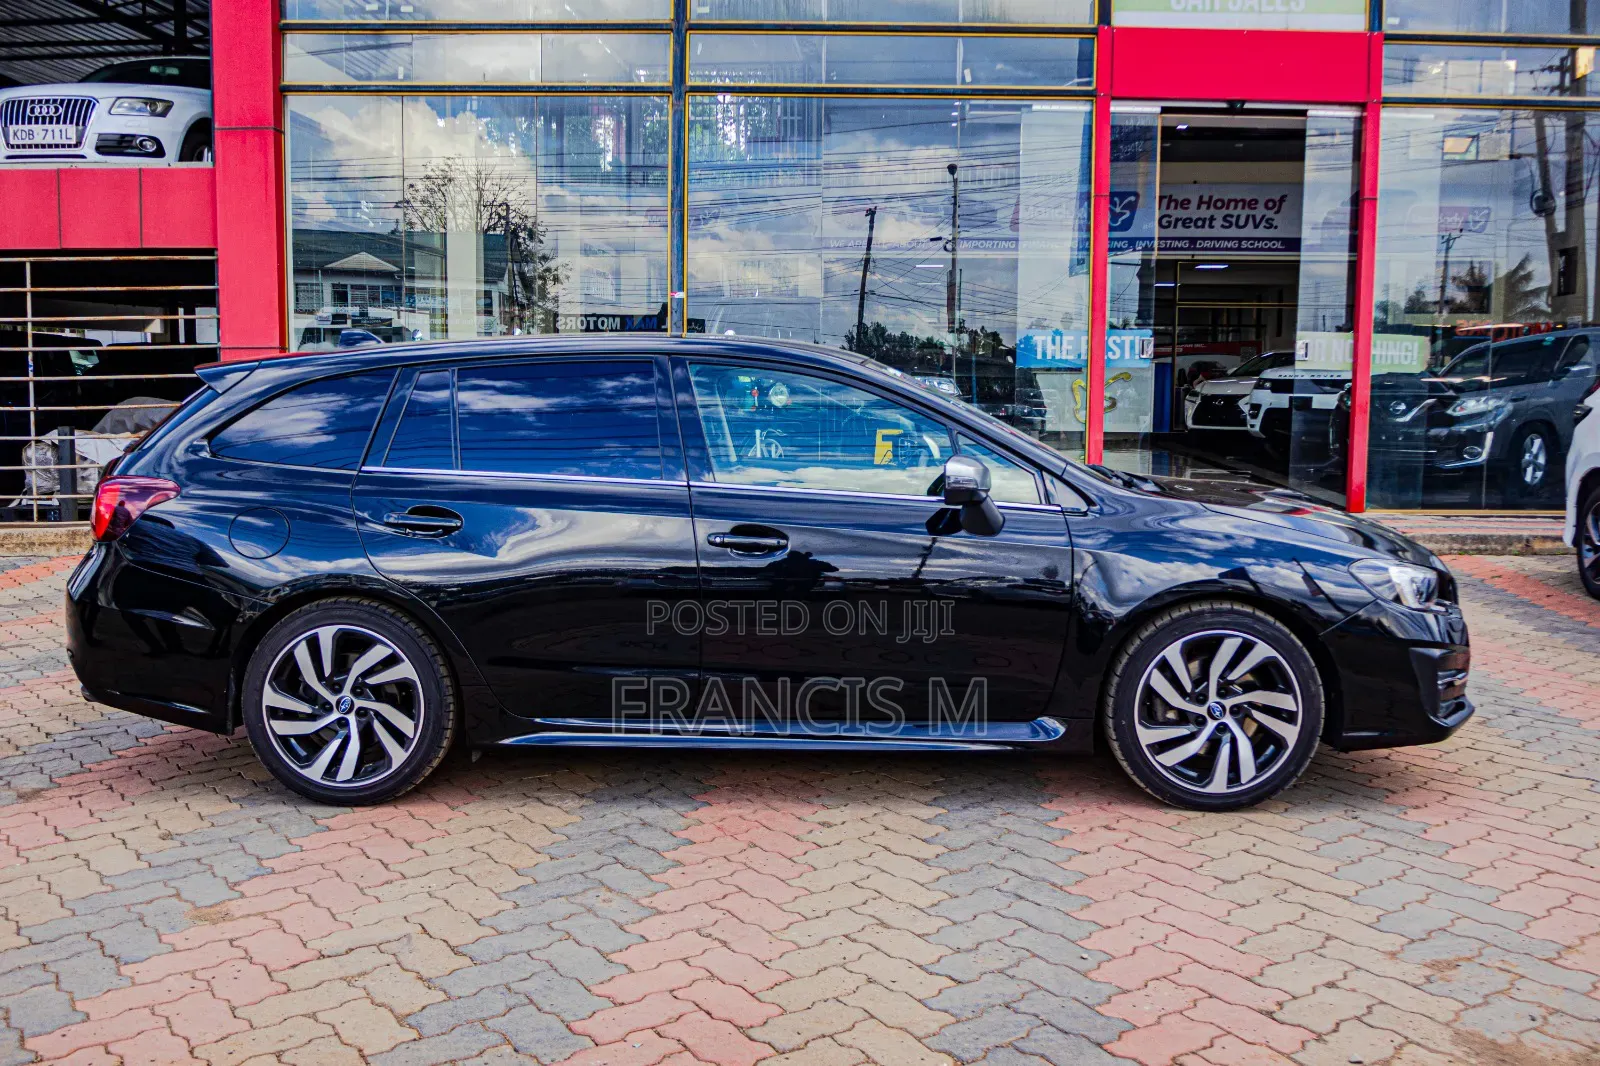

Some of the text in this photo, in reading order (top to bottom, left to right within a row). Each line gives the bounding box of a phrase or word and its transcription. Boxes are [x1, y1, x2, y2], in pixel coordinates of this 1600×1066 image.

[12, 128, 73, 141] KDB 711L
[1158, 194, 1289, 215] The Home of
[1158, 214, 1217, 230] Great
[1220, 214, 1279, 230] SUVs.
[1196, 240, 1238, 249] DRIVING
[1033, 335, 1074, 360] THE
